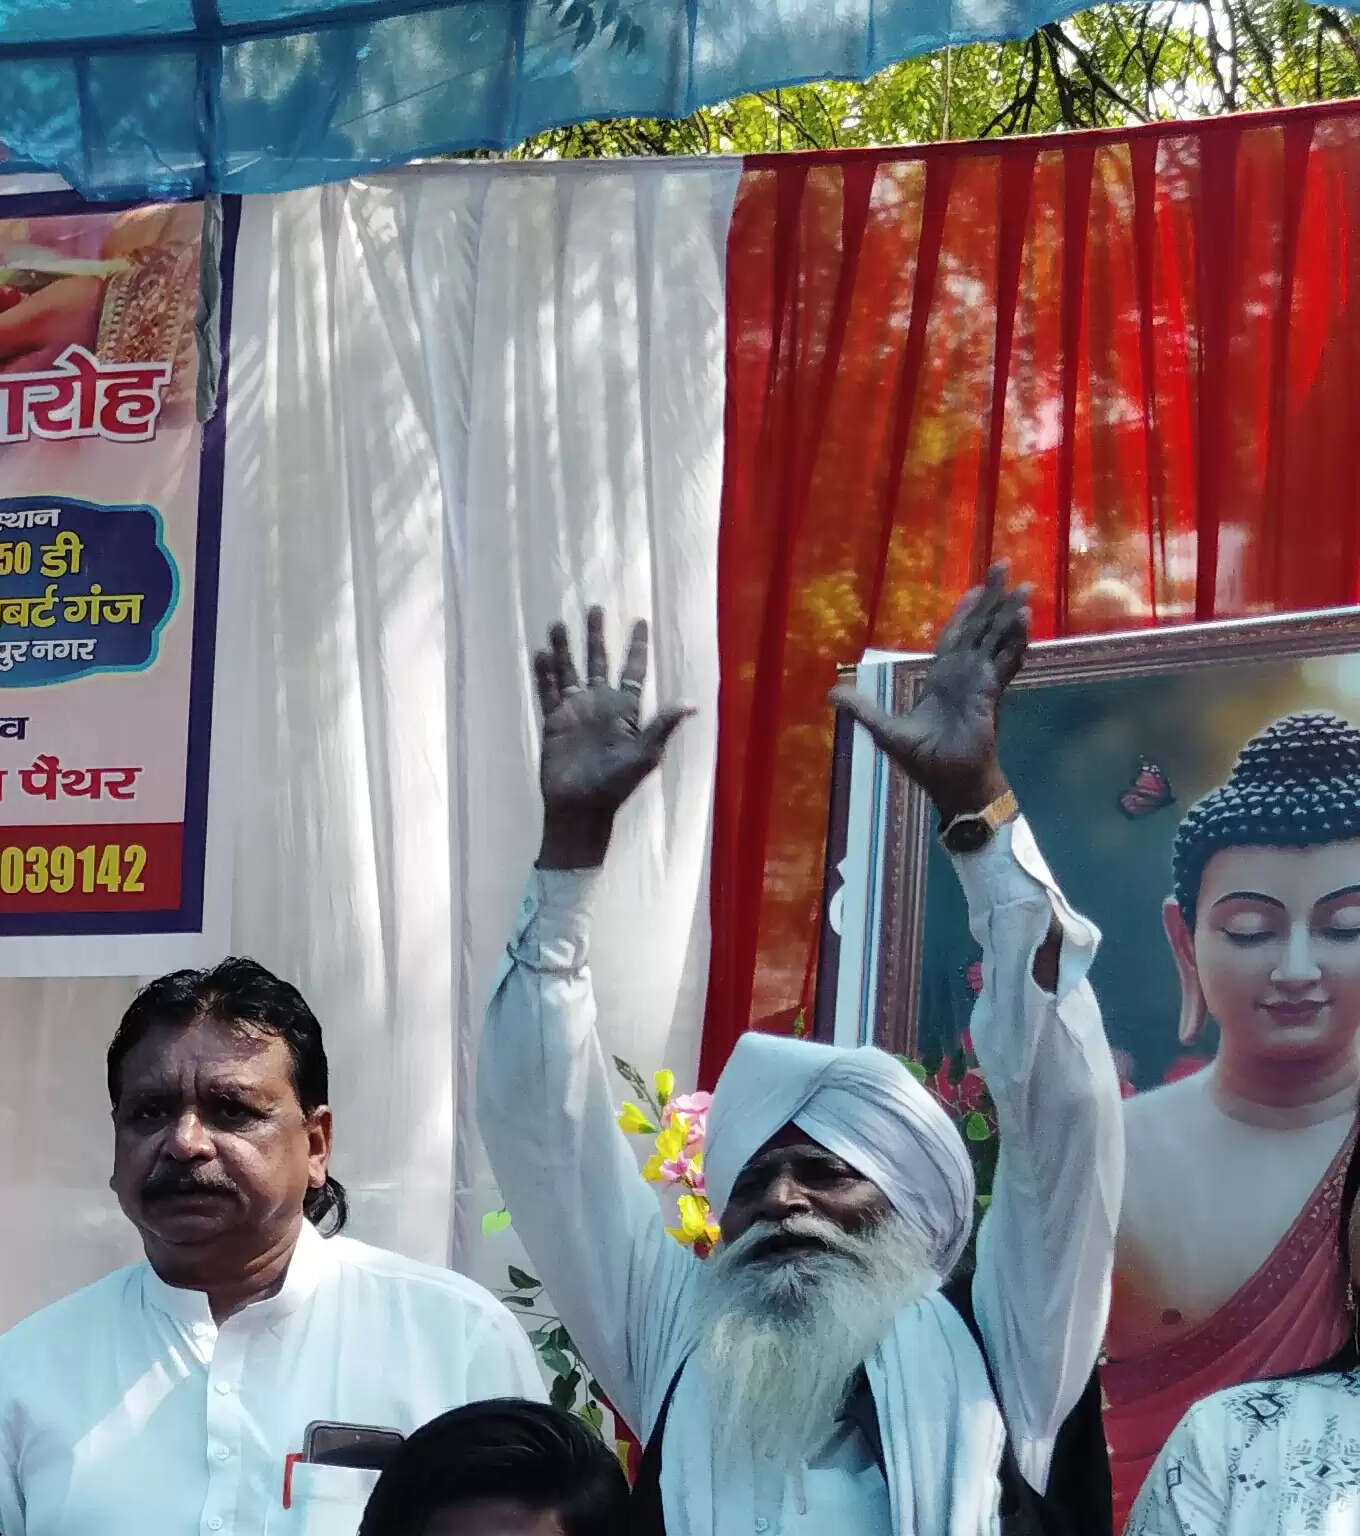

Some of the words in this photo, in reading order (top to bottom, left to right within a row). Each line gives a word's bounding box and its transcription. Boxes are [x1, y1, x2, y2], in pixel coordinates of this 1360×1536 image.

[40, 531, 84, 578] डी
[63, 583, 145, 625] गंज
[31, 638, 98, 661] नगर
